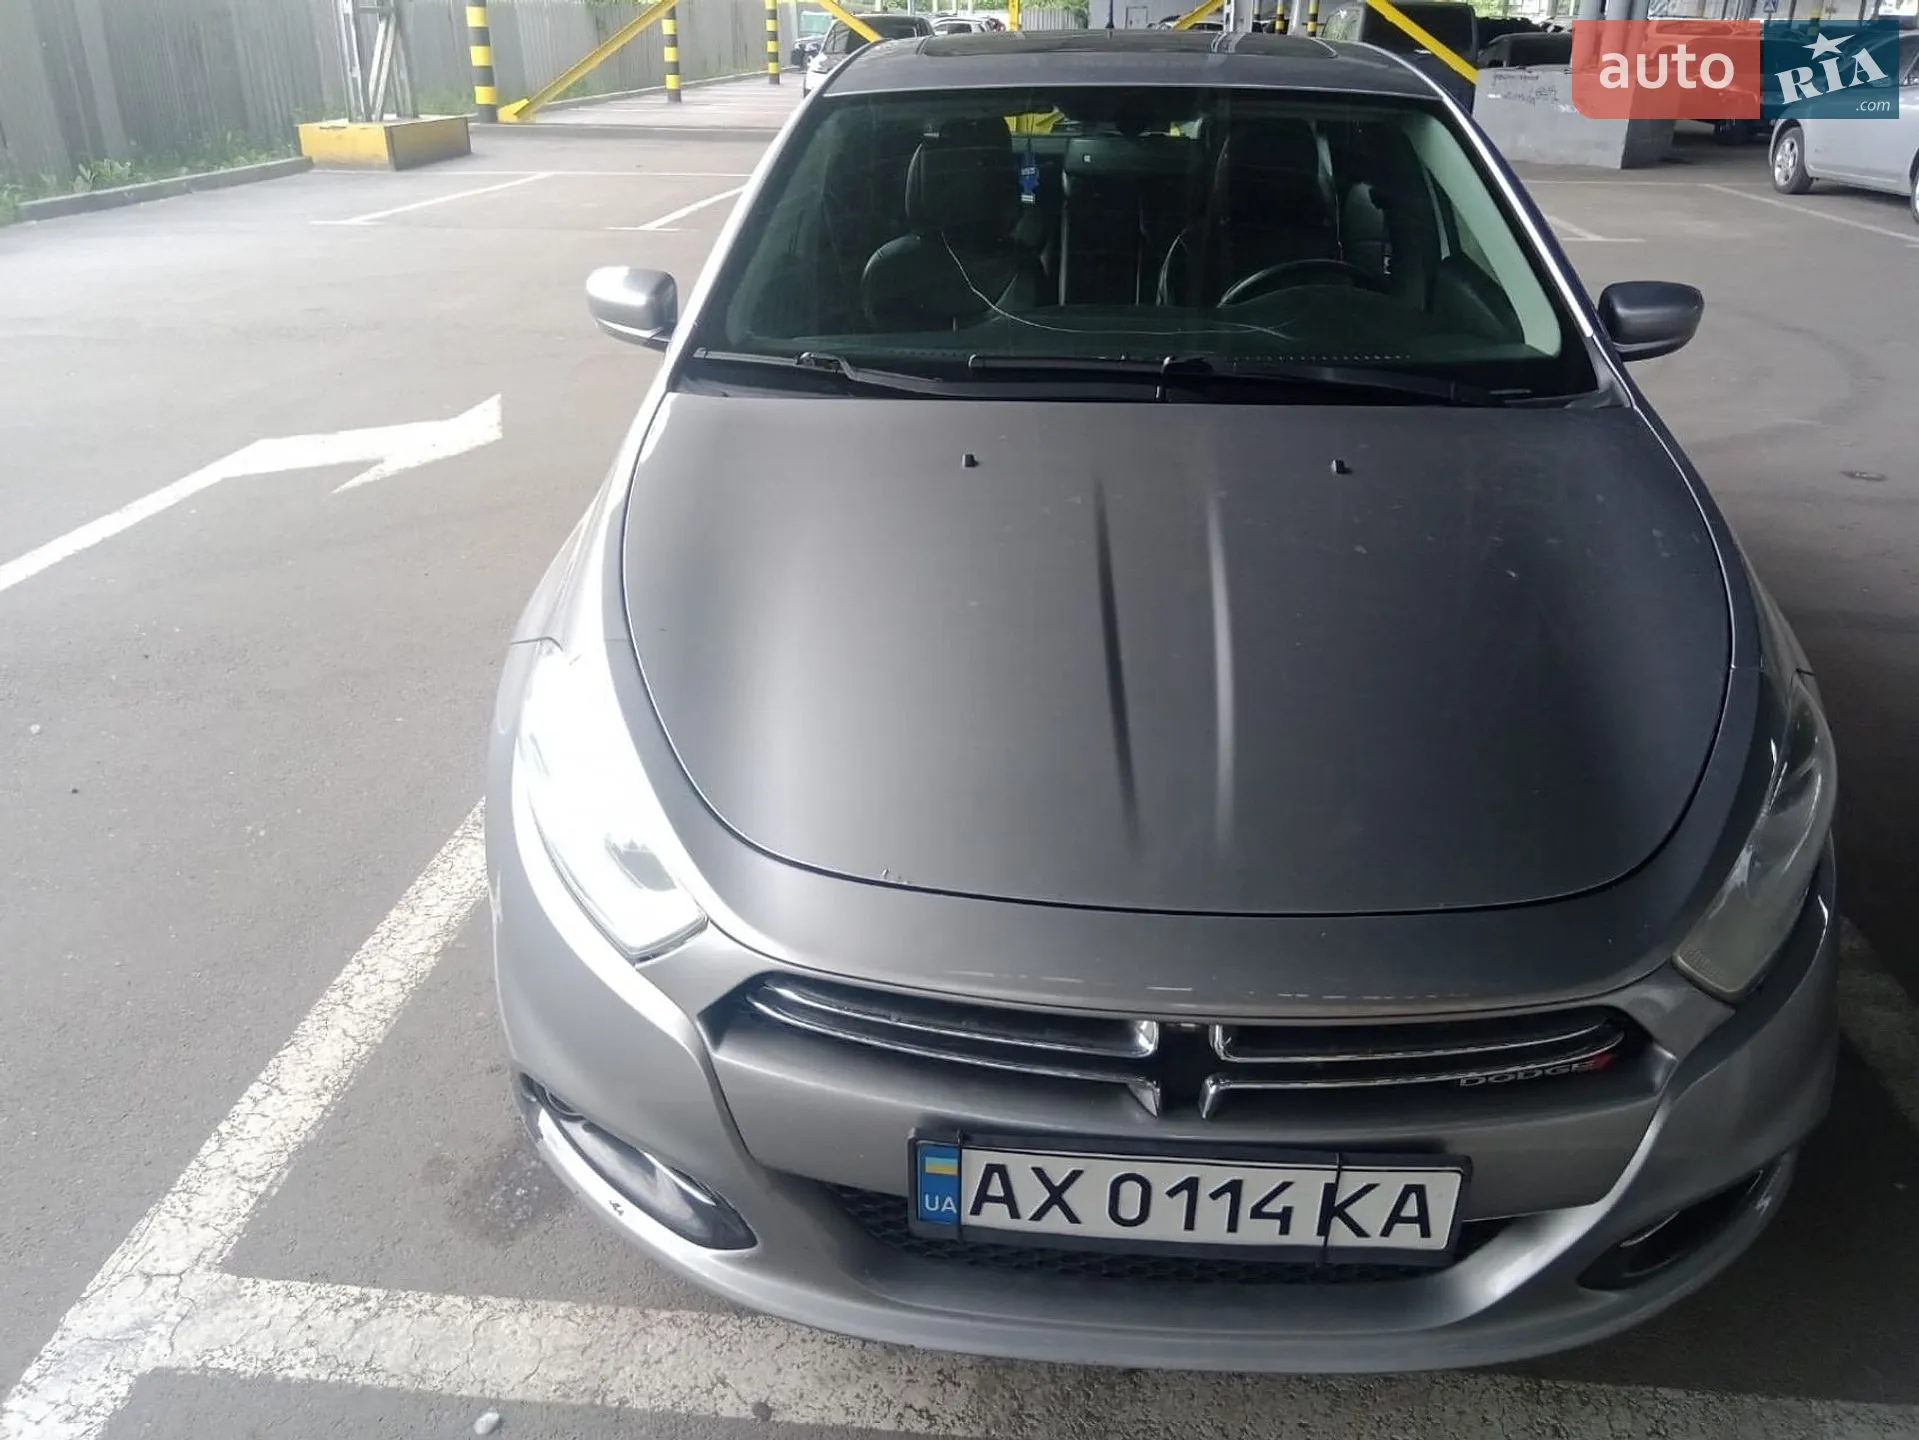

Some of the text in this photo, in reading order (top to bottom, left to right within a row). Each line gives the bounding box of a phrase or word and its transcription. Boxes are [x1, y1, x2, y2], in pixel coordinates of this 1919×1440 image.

[924, 1192, 957, 1213] UA
[969, 1163, 1433, 1239] AX 0114 KA
